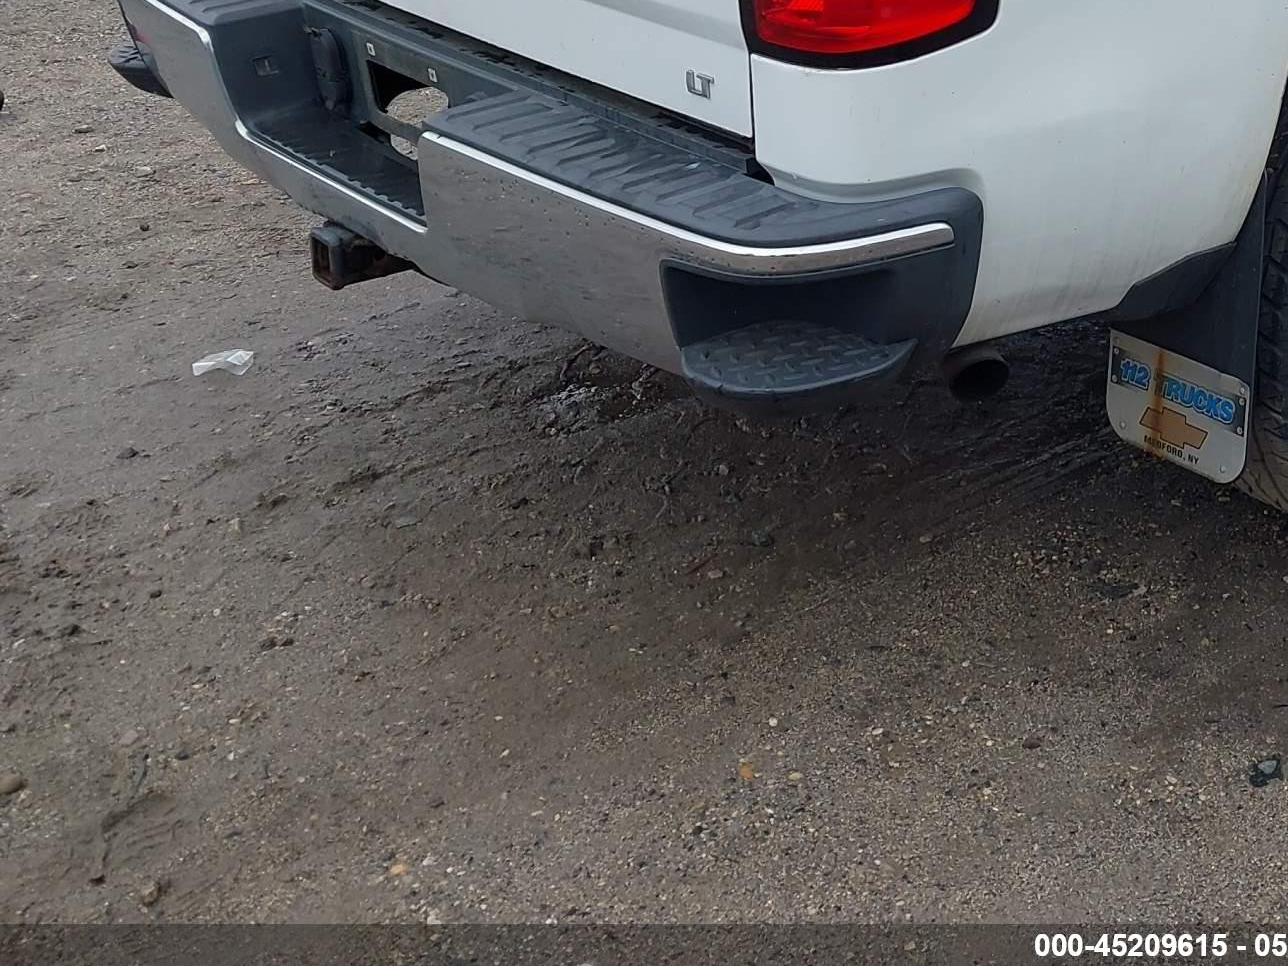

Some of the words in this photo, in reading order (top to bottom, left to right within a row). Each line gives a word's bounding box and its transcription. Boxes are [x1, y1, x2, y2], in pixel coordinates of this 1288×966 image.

[685, 69, 715, 100] LT
[1154, 368, 1236, 424] TRUCKS
[1187, 454, 1200, 465] NY
